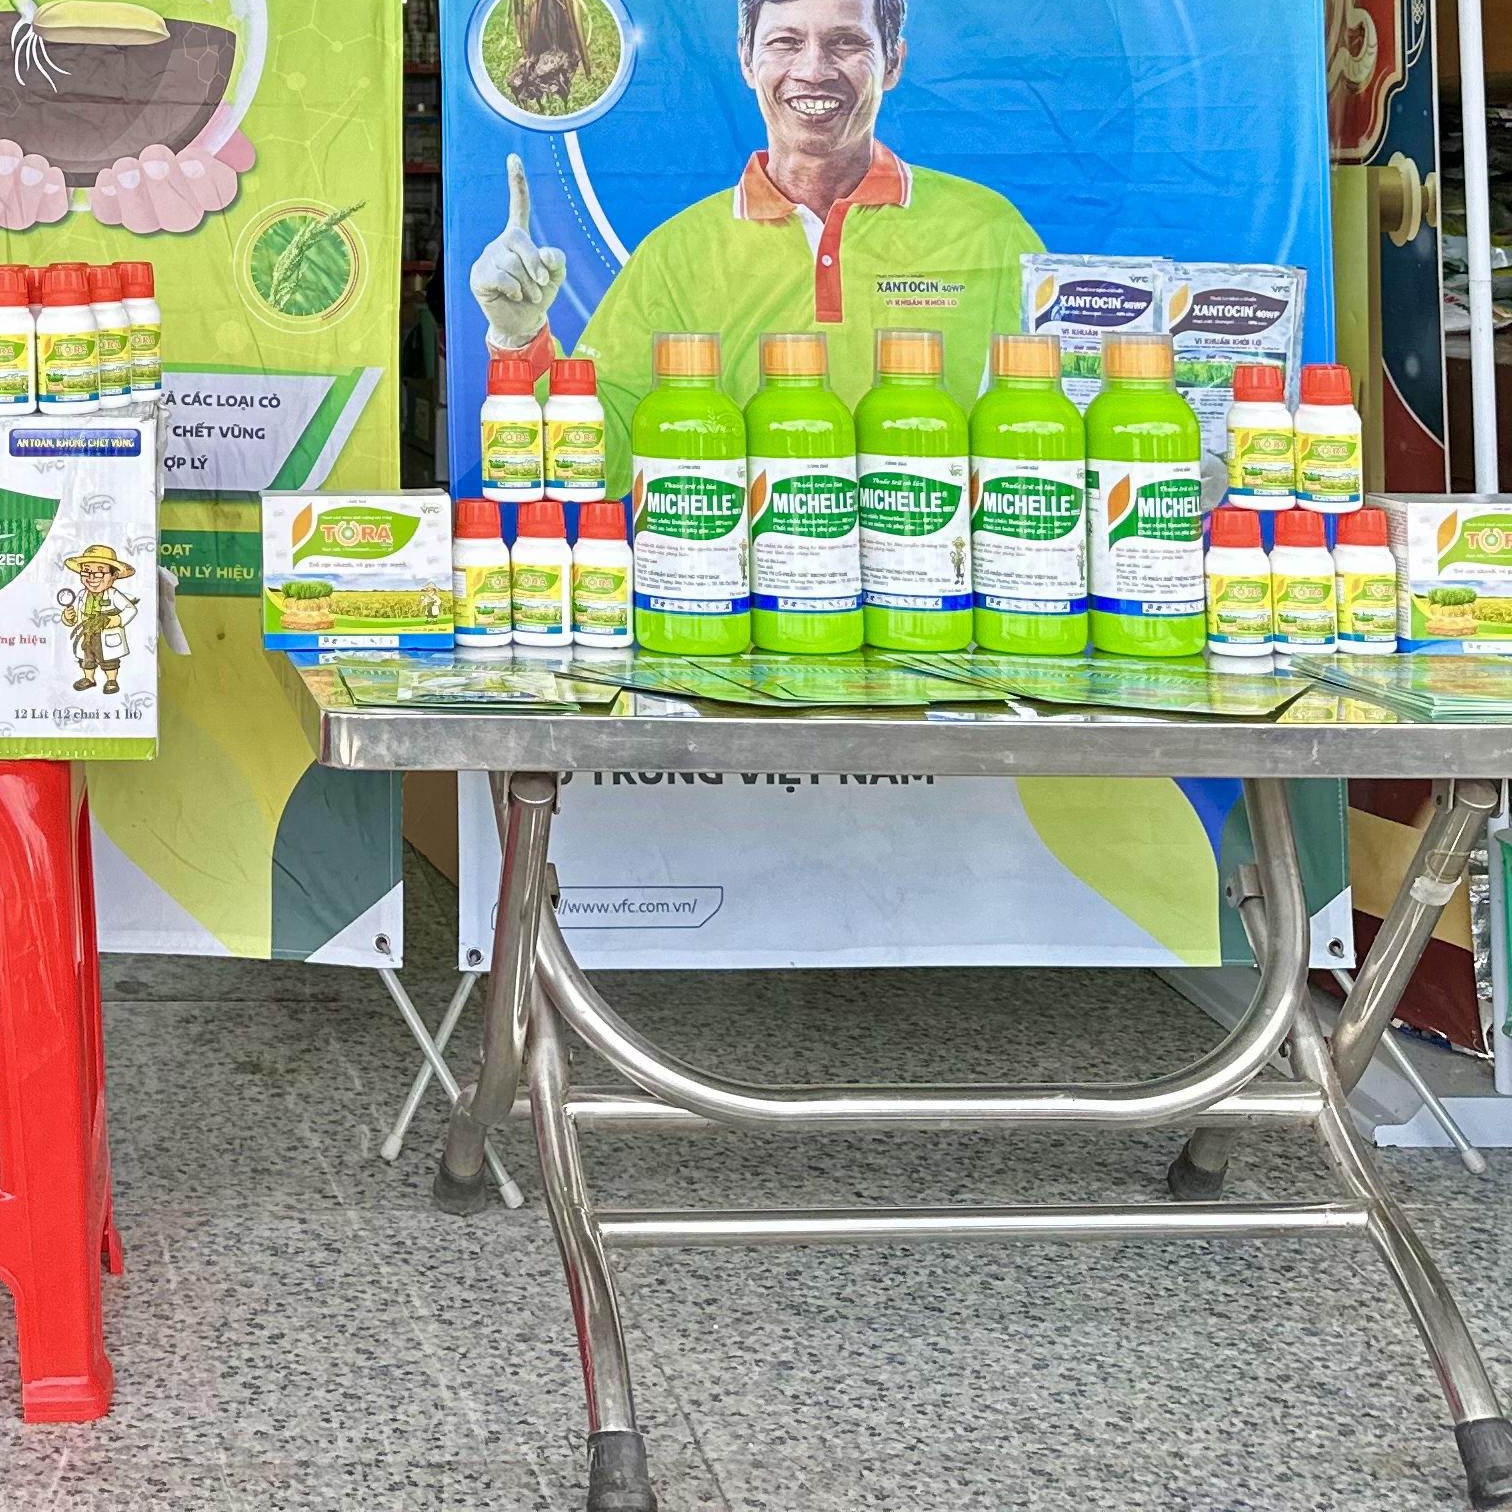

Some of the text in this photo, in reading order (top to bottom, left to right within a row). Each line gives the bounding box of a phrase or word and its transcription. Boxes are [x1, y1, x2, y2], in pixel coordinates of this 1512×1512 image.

[877, 281, 939, 293] XANTOCIN
[1059, 295, 1122, 309] XANTOCIN
[1192, 304, 1254, 318] XANTOCIN
[181, 392, 213, 408] CÁC
[216, 394, 255, 412] LOẠI
[259, 392, 281, 409] CỎ
[172, 421, 266, 441] CHẾT VŨNG
[190, 454, 209, 471] LÝ
[648, 491, 732, 516] MICHELLE
[772, 491, 854, 514] MICHELLE
[859, 487, 942, 513] MICHELLE
[983, 491, 1071, 516] MICHELLE
[160, 543, 193, 558] OẠT
[195, 562, 213, 579] LÝ
[216, 563, 255, 582] HIỆU
[19, 634, 47, 647] hiệu
[14, 708, 28, 720] 12
[103, 711, 111, 720] x
